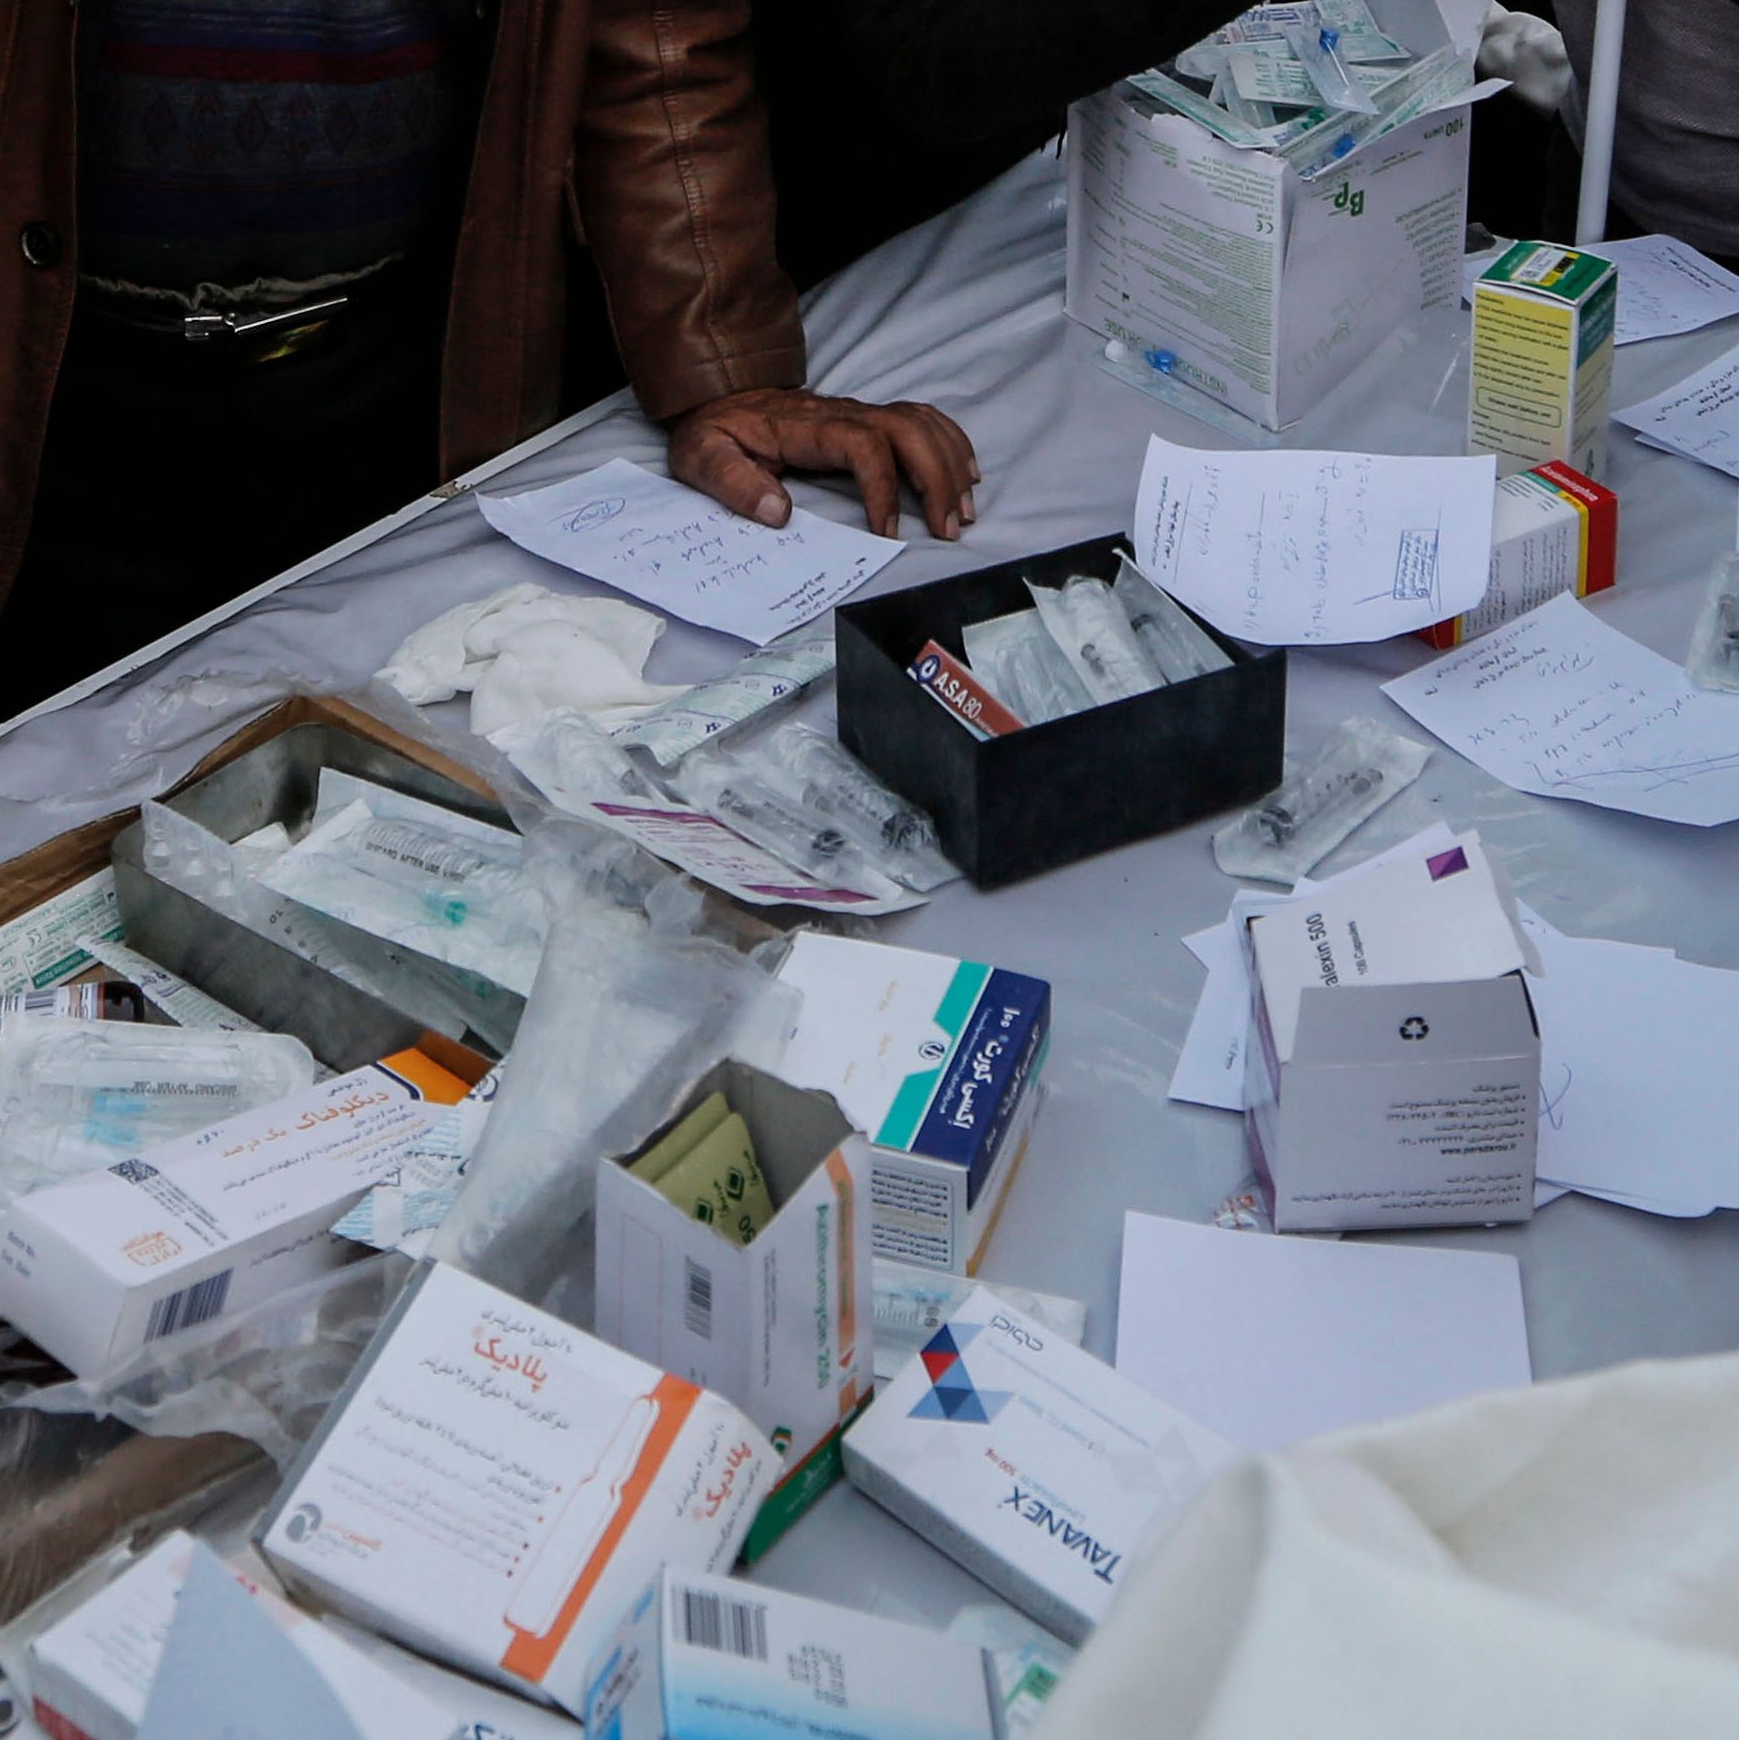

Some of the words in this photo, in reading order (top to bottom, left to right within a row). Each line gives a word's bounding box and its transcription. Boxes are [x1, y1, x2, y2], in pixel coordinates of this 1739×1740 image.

[1304, 912, 1327, 941] 500
[1316, 941, 1340, 987] alexin
[292, 1080, 392, 1139] دیکلوفناک
[465, 1330, 554, 1396] پلادیک
[999, 1484, 1120, 1586] TAVANEX
